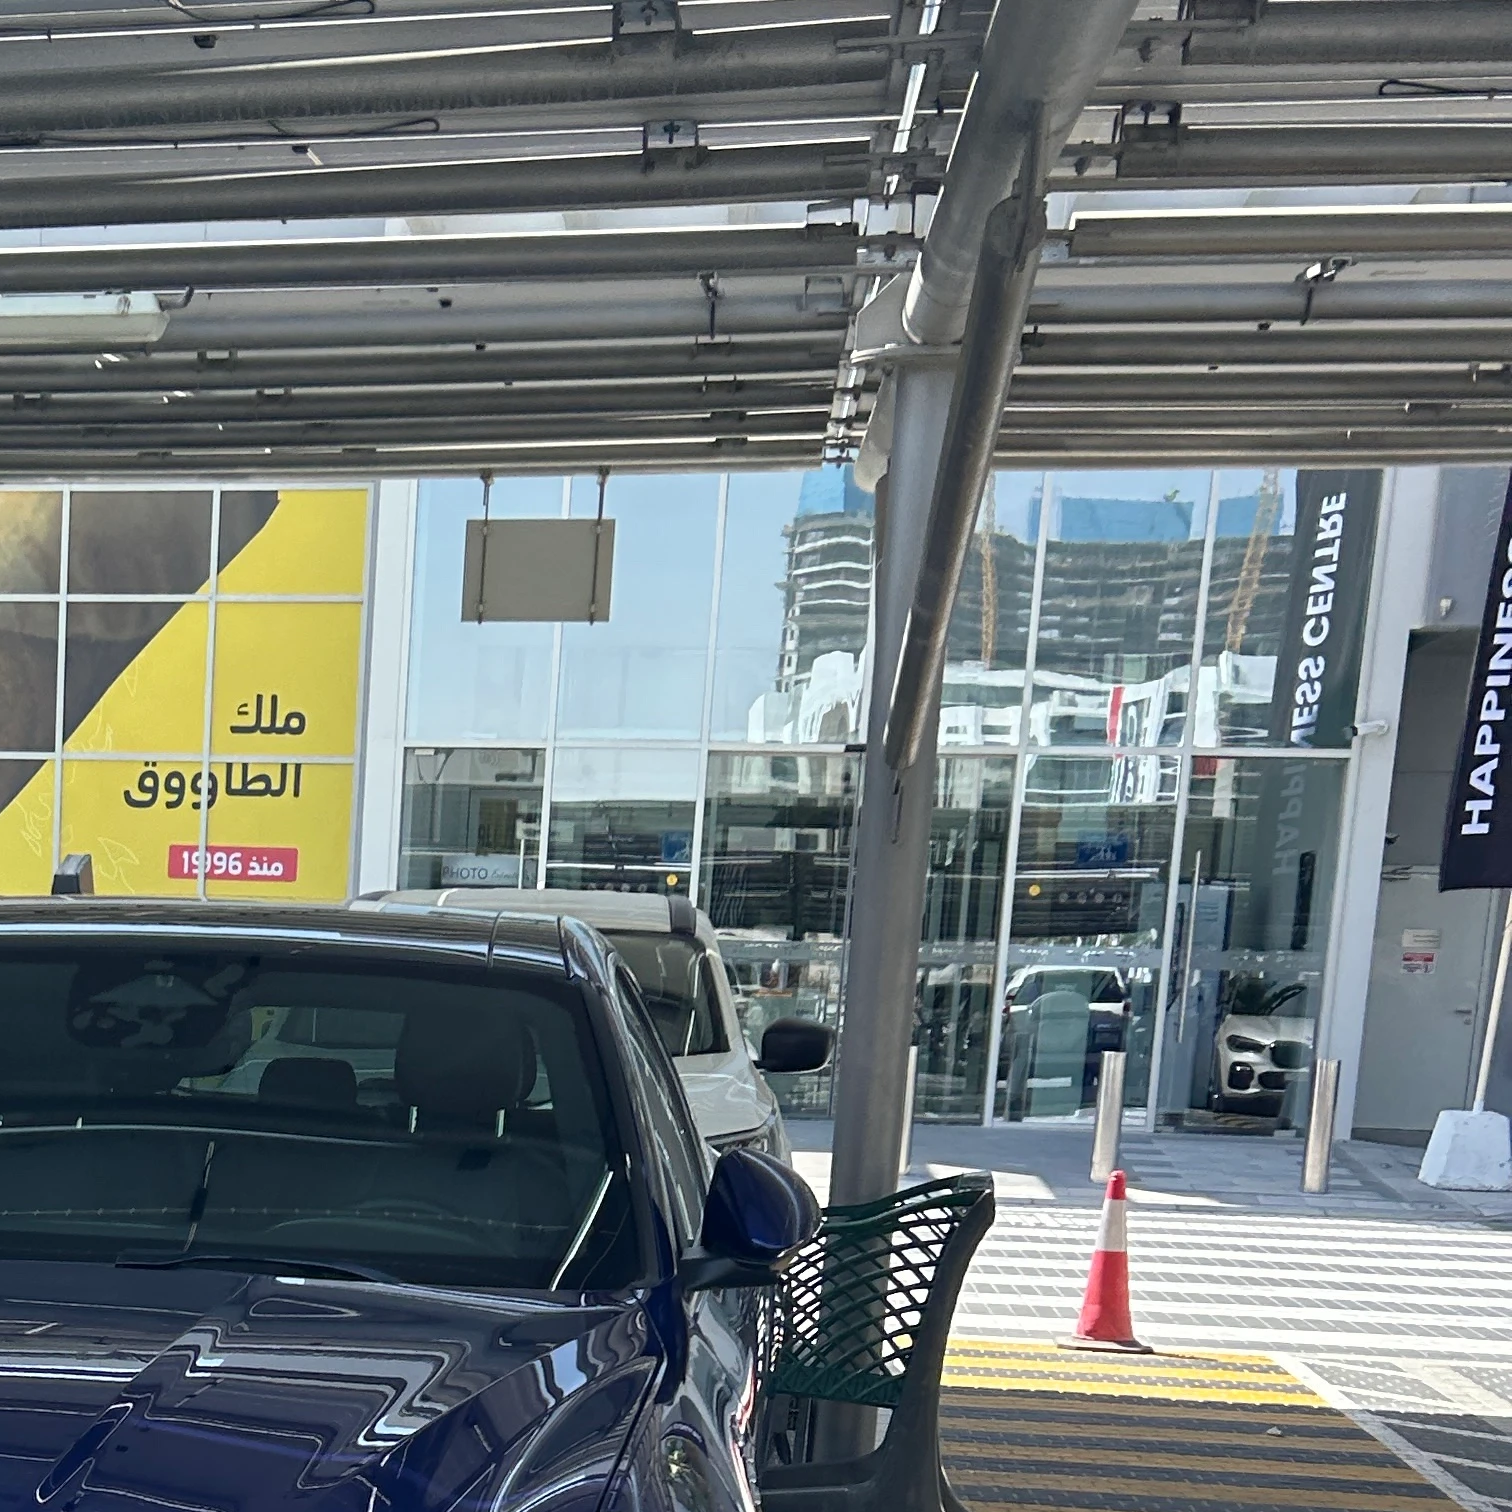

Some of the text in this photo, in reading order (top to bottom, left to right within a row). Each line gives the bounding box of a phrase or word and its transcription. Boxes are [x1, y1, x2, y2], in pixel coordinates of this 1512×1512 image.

[230, 694, 306, 735] ملك
[123, 761, 302, 810] الطاووق
[182, 851, 284, 877] منذ 1996
[442, 865, 488, 880] PHOTO
